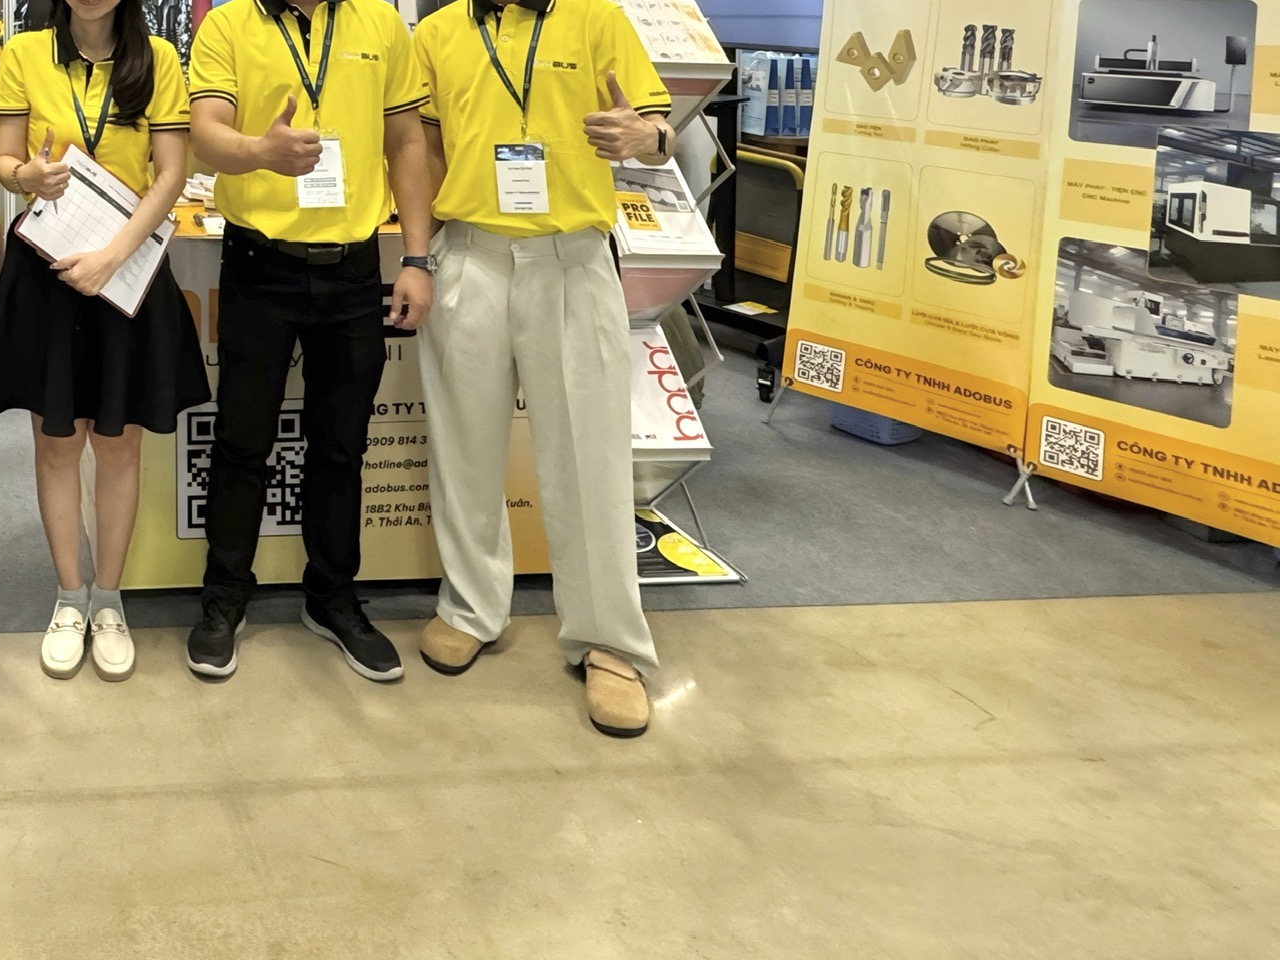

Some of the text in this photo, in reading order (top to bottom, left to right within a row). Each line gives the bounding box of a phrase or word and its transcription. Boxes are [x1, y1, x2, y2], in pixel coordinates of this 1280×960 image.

[621, 202, 650, 213] PRO
[625, 212, 655, 222] FILE
[854, 357, 1013, 410] CÔNG TY TNHH ADOBUS
[392, 402, 415, 416] TY
[364, 436, 395, 447] 0909
[397, 436, 418, 445] 814
[365, 458, 428, 470] hotline@ad
[1116, 440, 1168, 462] CÔNG
[1171, 454, 1196, 470] TY
[1200, 461, 1253, 487] TNHH
[365, 504, 392, 514] 18B2
[394, 503, 415, 513] Khu
